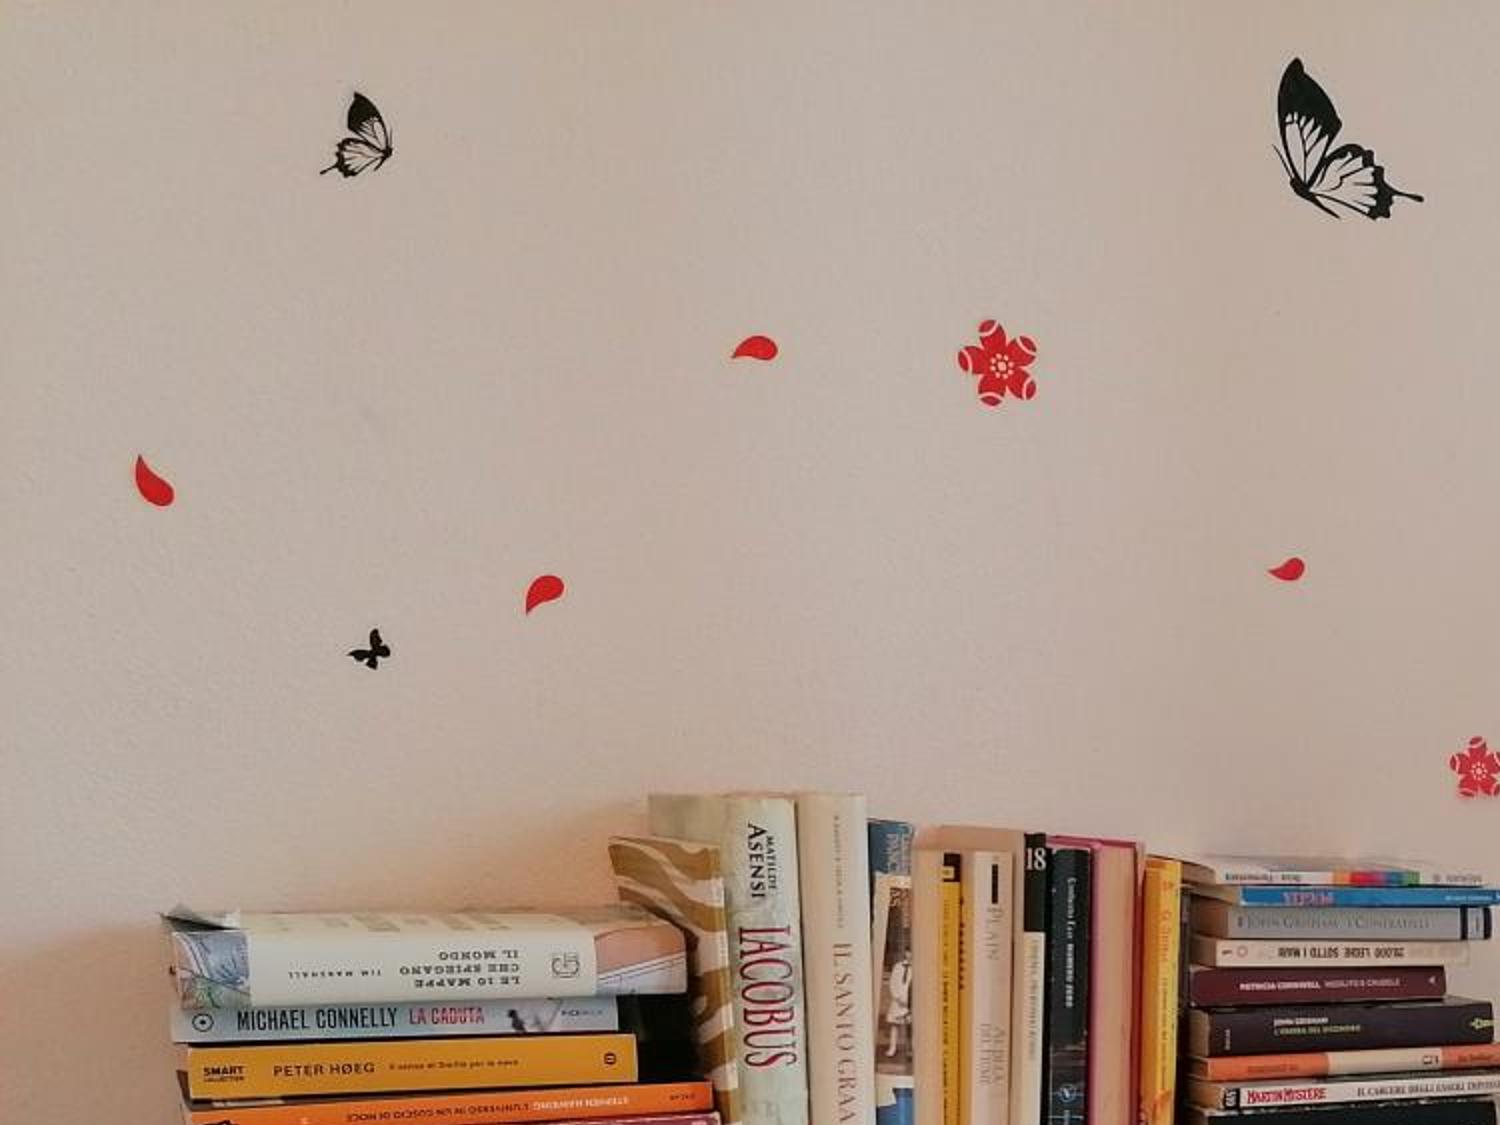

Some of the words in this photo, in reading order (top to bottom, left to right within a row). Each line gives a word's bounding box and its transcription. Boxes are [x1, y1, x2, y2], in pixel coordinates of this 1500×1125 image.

[747, 823, 767, 899] ASENSI
[766, 835, 777, 889] MATILDE
[1026, 847, 1047, 871] 18
[438, 951, 497, 961] MONDO
[504, 950, 519, 959] IL
[832, 943, 853, 966] IL
[399, 965, 481, 976] SPIEGANO
[488, 964, 520, 974] CHE
[415, 978, 471, 988] MAPPE
[503, 976, 520, 985] LE
[738, 925, 797, 1068] IACOBUS
[237, 1010, 310, 1031] MICHAEL
[316, 1007, 398, 1029] CONNELLY
[409, 1008, 427, 1025] LA
[431, 1007, 485, 1024] CADUTA
[833, 972, 854, 1052] SANTO
[203, 1065, 244, 1076] SMART
[273, 1063, 324, 1077] PETER
[328, 1061, 376, 1076] HØEG
